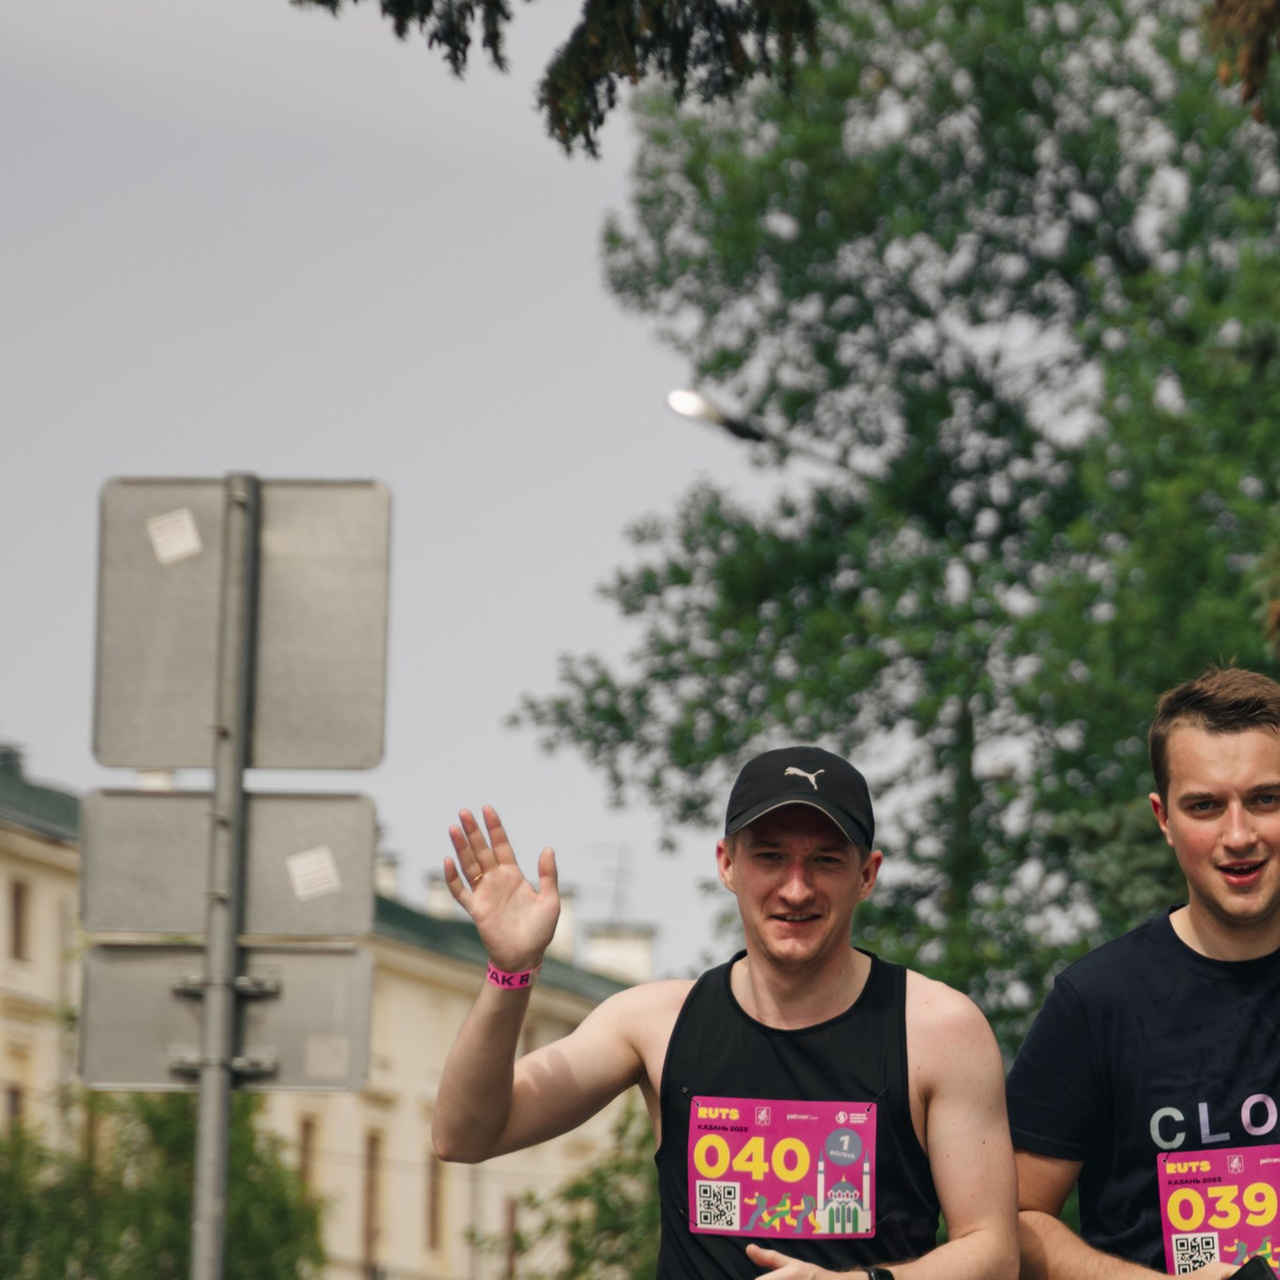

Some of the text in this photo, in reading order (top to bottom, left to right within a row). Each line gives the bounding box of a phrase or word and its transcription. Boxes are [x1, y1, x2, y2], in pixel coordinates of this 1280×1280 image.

[488, 968, 514, 986] AK
[698, 1107, 740, 1120] RUTS
[697, 1124, 728, 1132] КАЗАНЬ
[840, 1135, 850, 1151] 1
[693, 1133, 811, 1183] 040
[829, 1150, 855, 1159] ВОЛНА
[1166, 1161, 1211, 1174] RUTS
[1202, 1176, 1222, 1184] 2023
[1166, 1181, 1279, 1232] 039
